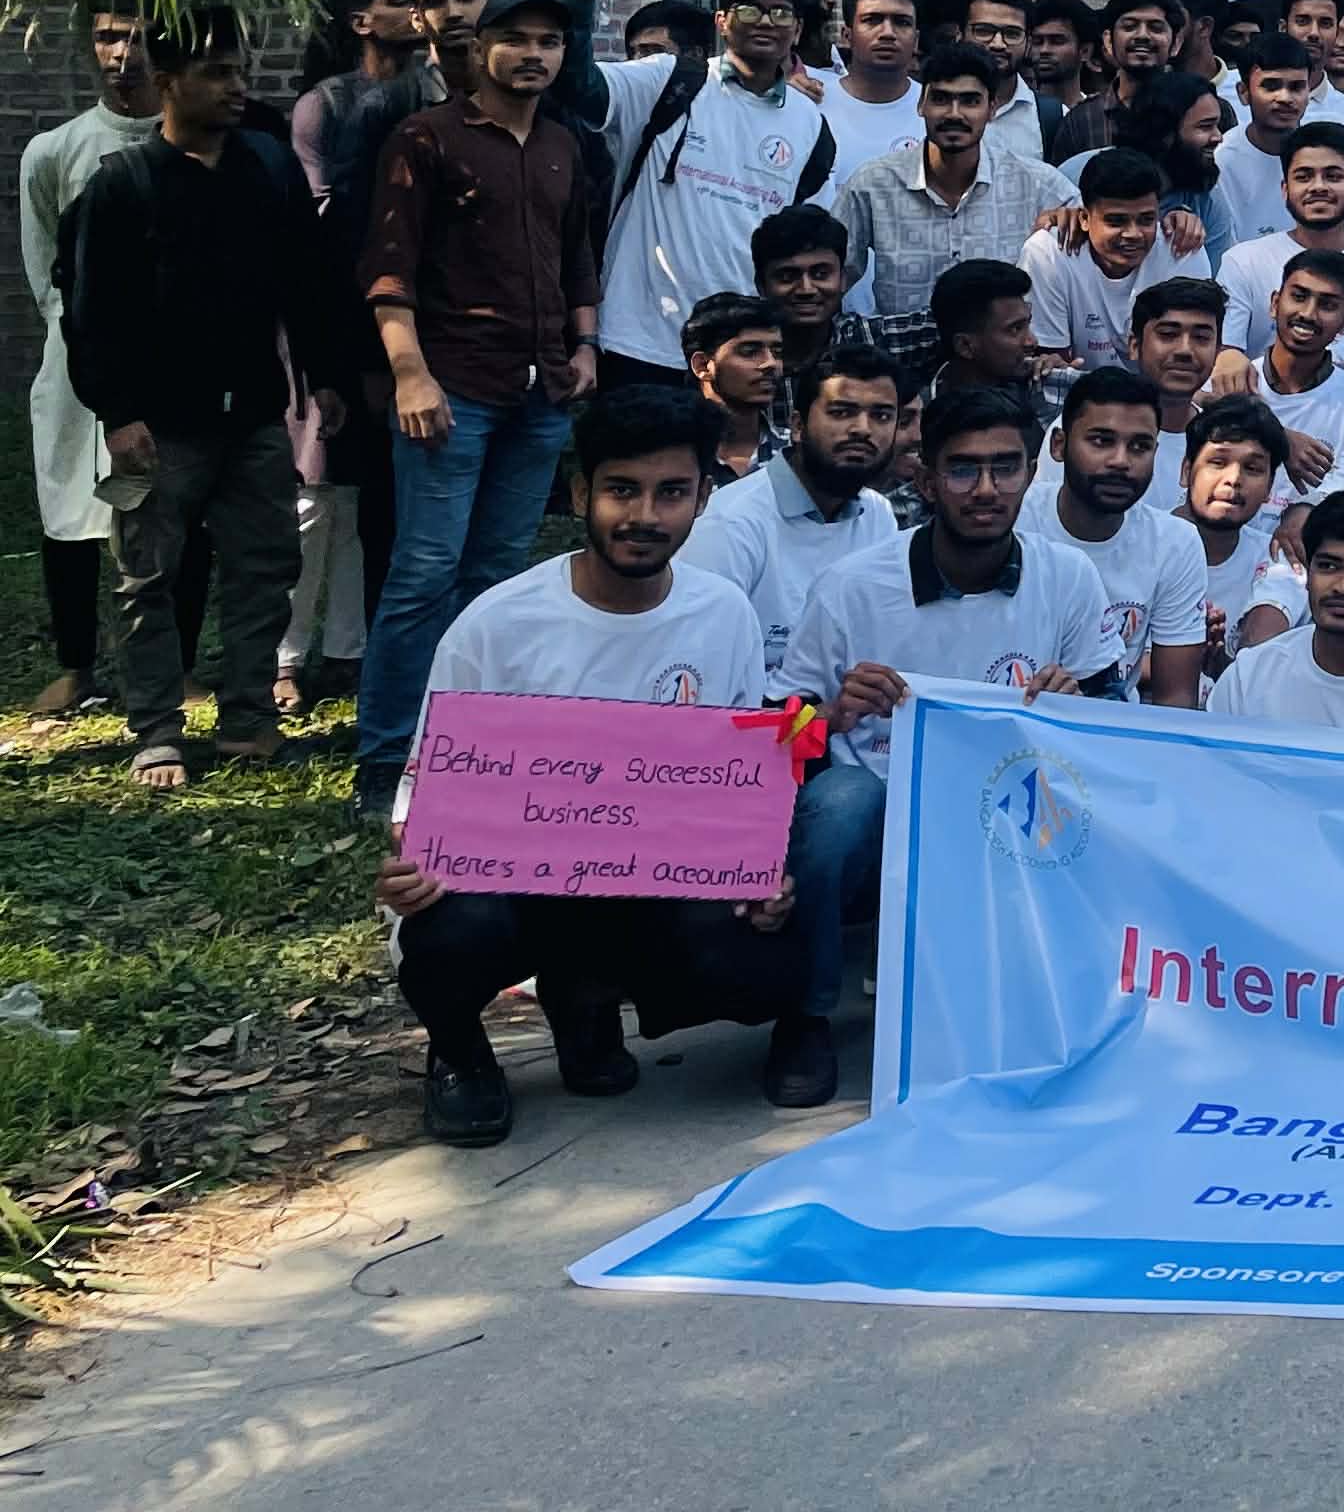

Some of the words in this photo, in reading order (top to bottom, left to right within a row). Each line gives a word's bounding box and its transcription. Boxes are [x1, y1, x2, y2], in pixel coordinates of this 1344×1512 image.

[428, 734, 516, 776] Behind
[529, 756, 605, 785] every
[625, 757, 765, 788] Successful
[523, 791, 640, 829] business,
[533, 860, 554, 879] a
[564, 853, 637, 894] great
[1192, 1185, 1336, 1212] Dept.
